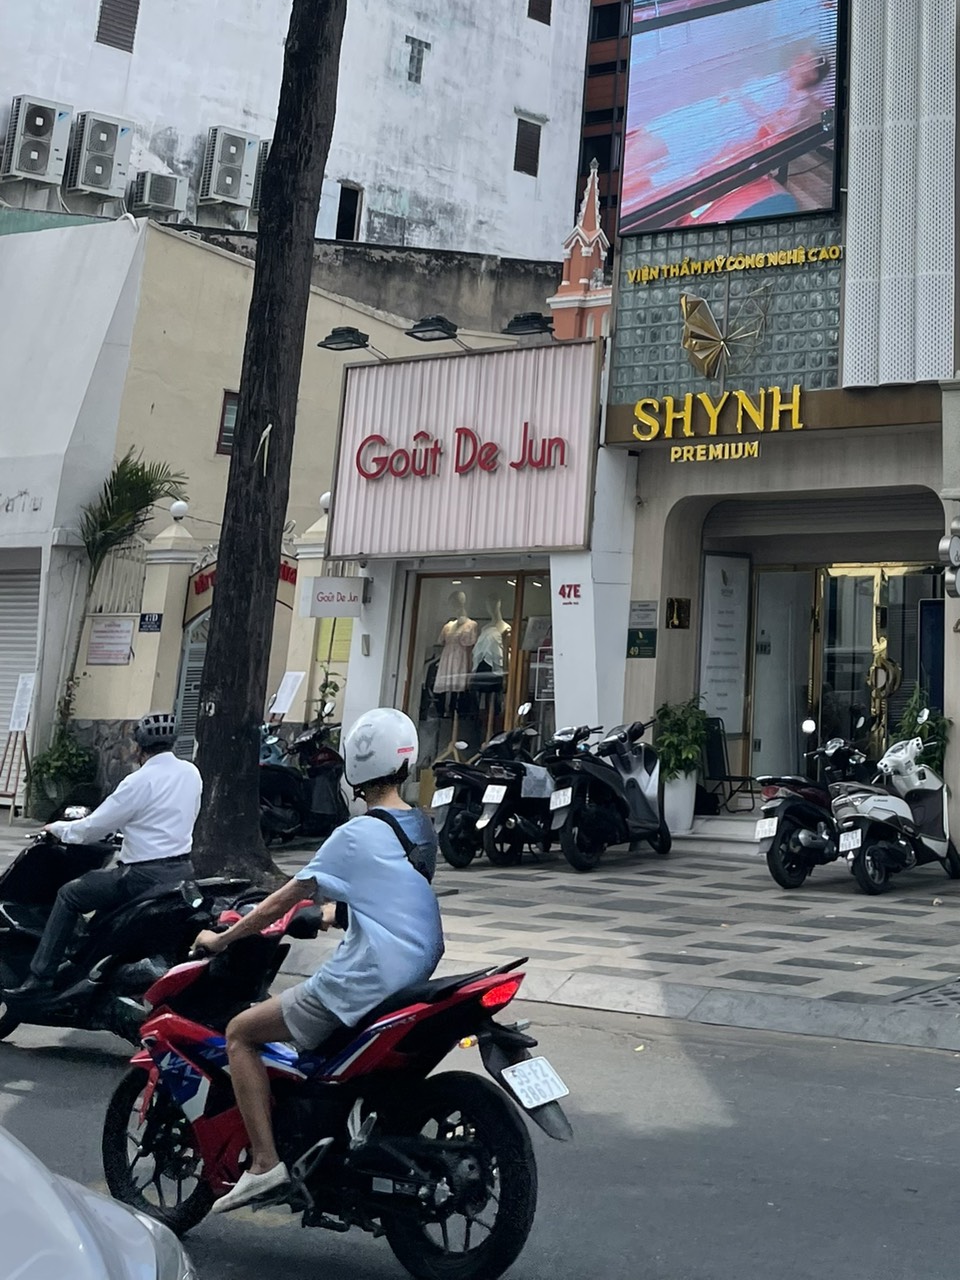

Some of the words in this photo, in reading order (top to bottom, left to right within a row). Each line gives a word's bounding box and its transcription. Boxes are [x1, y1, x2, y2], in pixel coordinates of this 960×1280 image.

[627, 266, 660, 285] VIỆN
[661, 257, 702, 279] THẨM
[703, 254, 727, 274] MỸ
[726, 252, 765, 271] CÔNG
[766, 246, 806, 266] NGHỆ
[807, 245, 841, 263] CAO
[632, 384, 804, 441] SHYNH
[355, 430, 444, 480] Goût
[455, 426, 501, 475] De
[509, 421, 568, 470] Jun
[670, 440, 760, 463] PREMIUM
[316, 590, 335, 603] Goût
[336, 590, 347, 602] De
[347, 591, 359, 603] Jun
[559, 583, 582, 599] 47E
